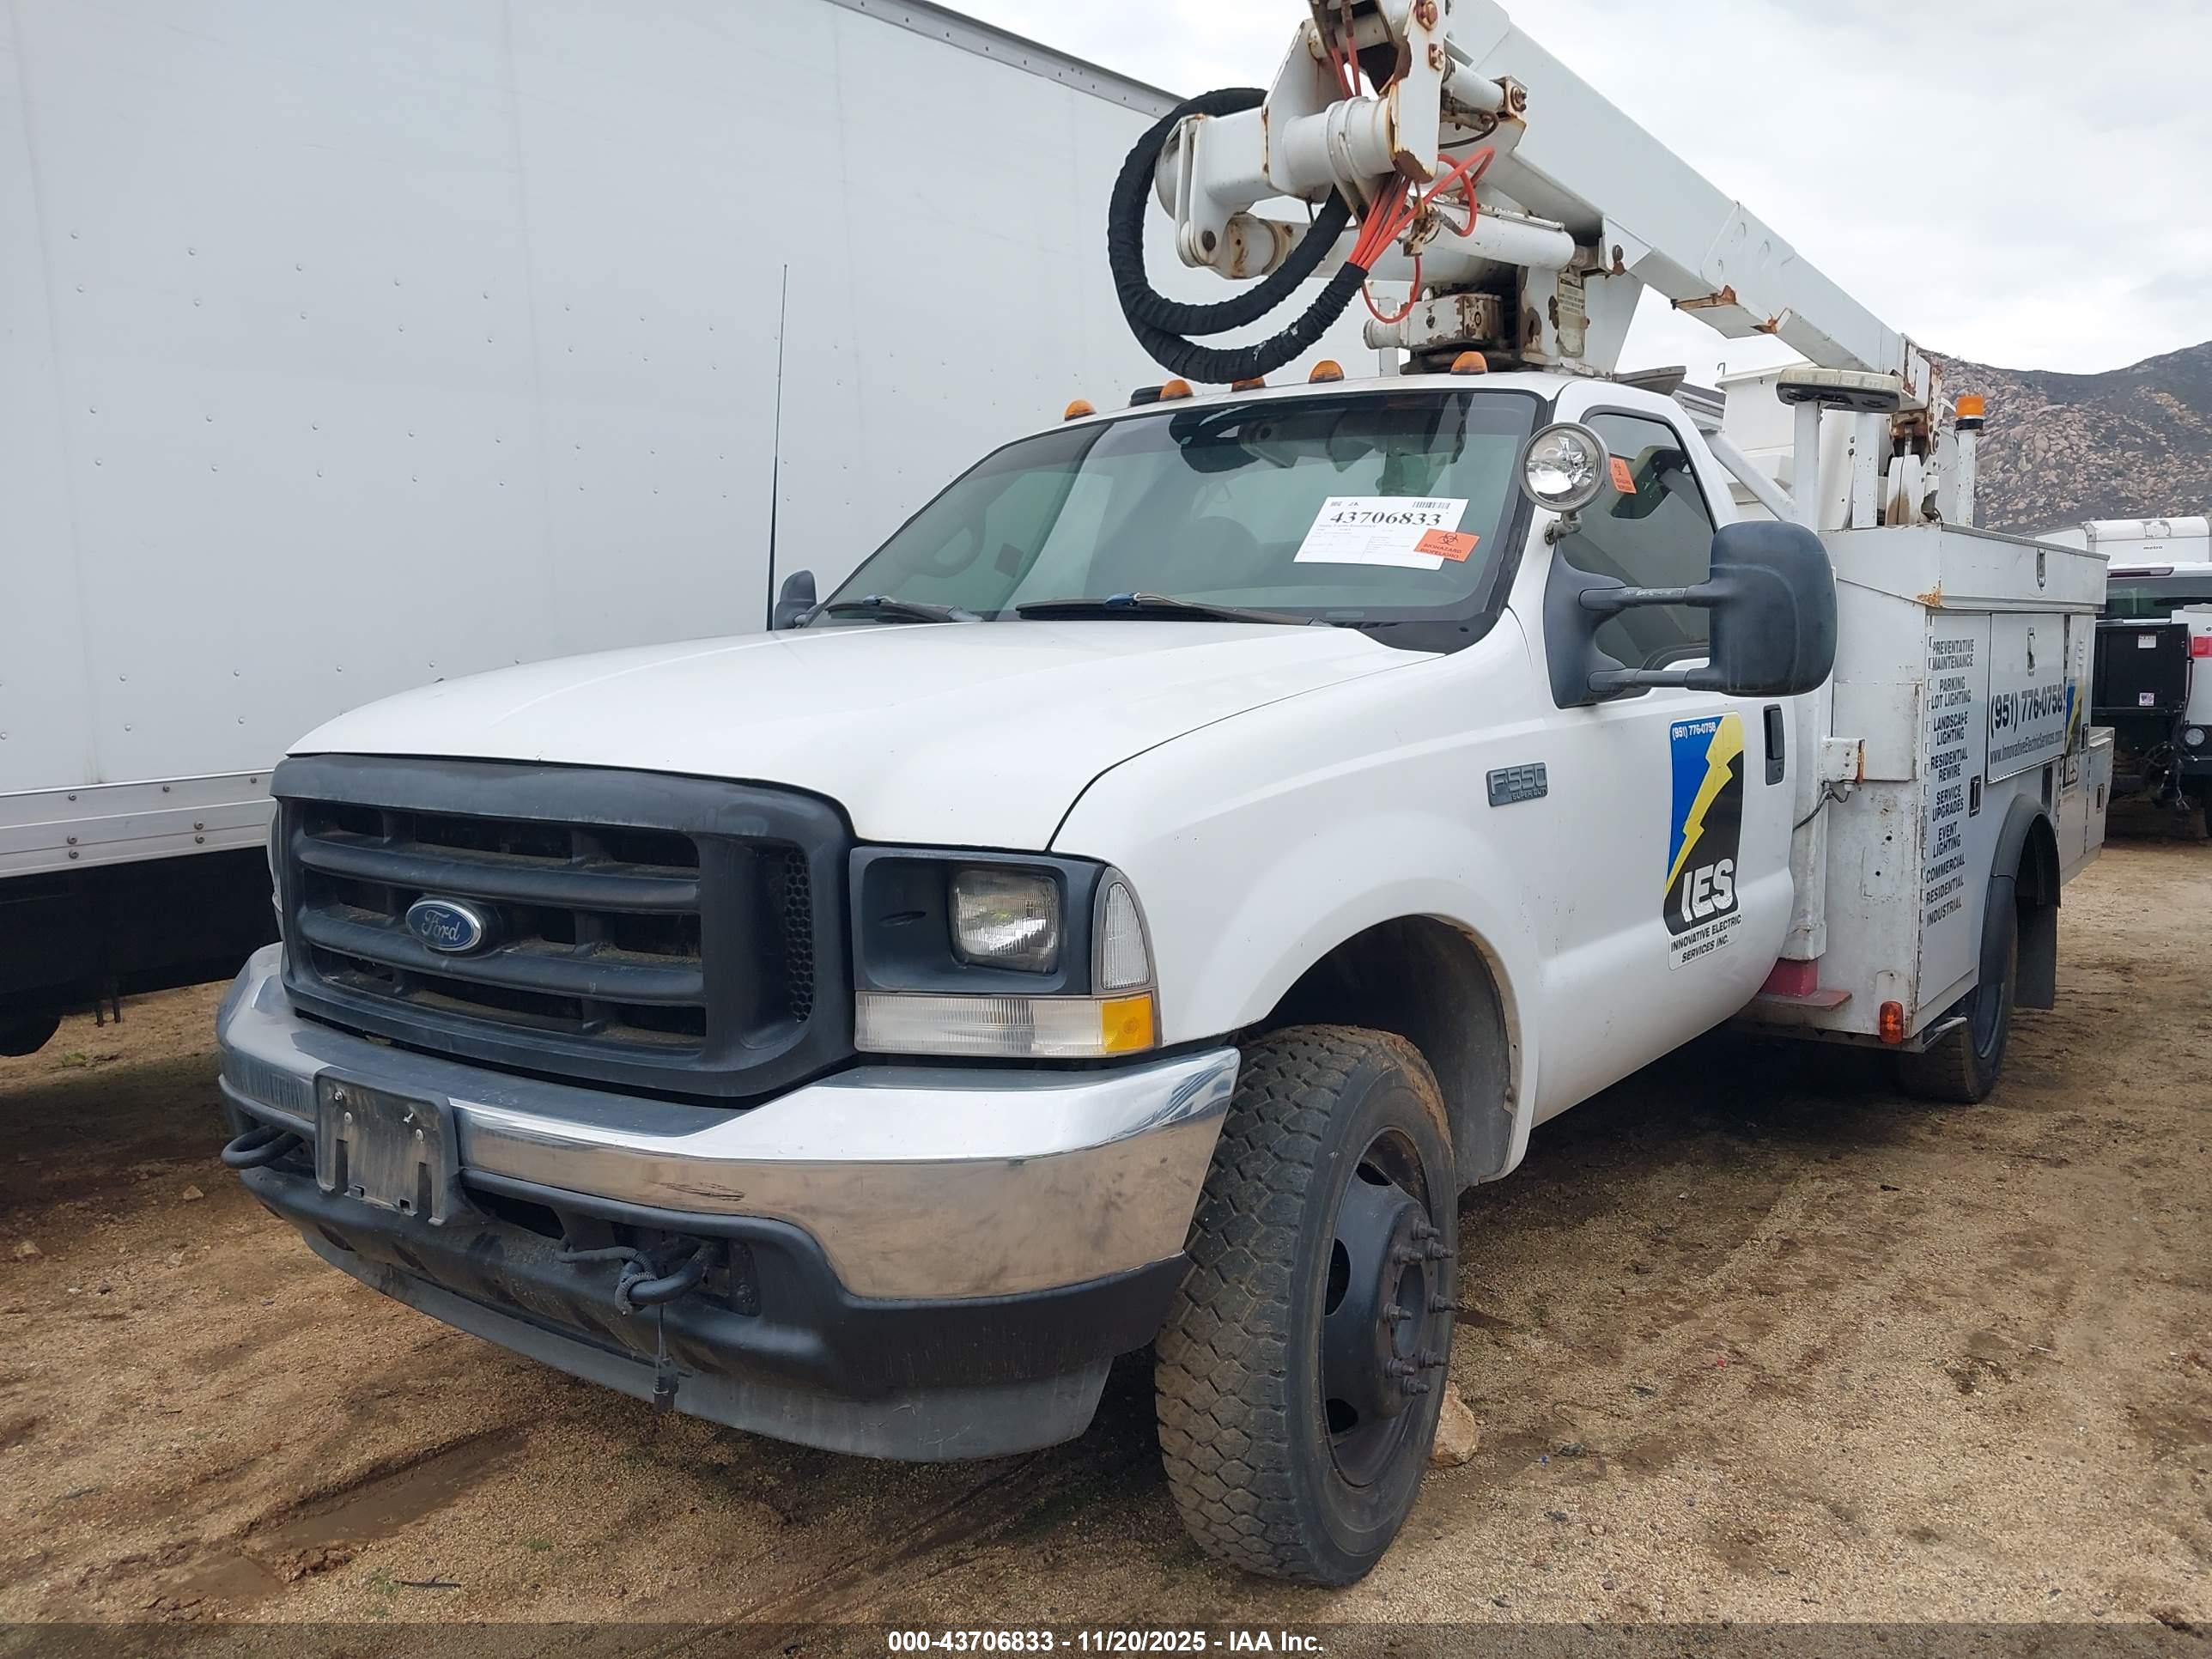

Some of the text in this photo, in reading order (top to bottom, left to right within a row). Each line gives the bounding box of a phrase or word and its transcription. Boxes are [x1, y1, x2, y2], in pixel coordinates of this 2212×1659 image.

[1330, 511, 1442, 526] 43706833
[1423, 543, 1462, 554] BIOHAZARD
[1932, 638, 1974, 656] PREVENTATIVE
[1931, 653, 1973, 672] MAINTENANCE
[1939, 676, 1966, 693] PARKING
[1931, 689, 1972, 710] LOT LIGHTING
[1933, 711, 1968, 732] LANDSCAPE
[1990, 684, 2063, 739] (951) 776-0758
[1672, 726, 1688, 741] (951)
[1936, 726, 1965, 747] LIGHTING
[1930, 746, 1968, 770] RESIDENTIAL
[1938, 763, 1961, 783] REWIRE
[1936, 784, 1961, 806] SERVICE
[1932, 797, 1964, 822] UPGRADES
[1938, 821, 1958, 842] EVENT
[1933, 833, 1961, 859] LIGHTING
[1926, 852, 1966, 884] COMMERCIAL
[1680, 858, 1734, 923] IES
[1926, 874, 1964, 907] RESIDENTIAL
[1926, 895, 1962, 928] INDUSTRIAL
[421, 909, 461, 941] Ford
[1670, 914, 1742, 953] INNOVATIVE ELECTRIC
[1681, 934, 1729, 963] SERVICES INC.
